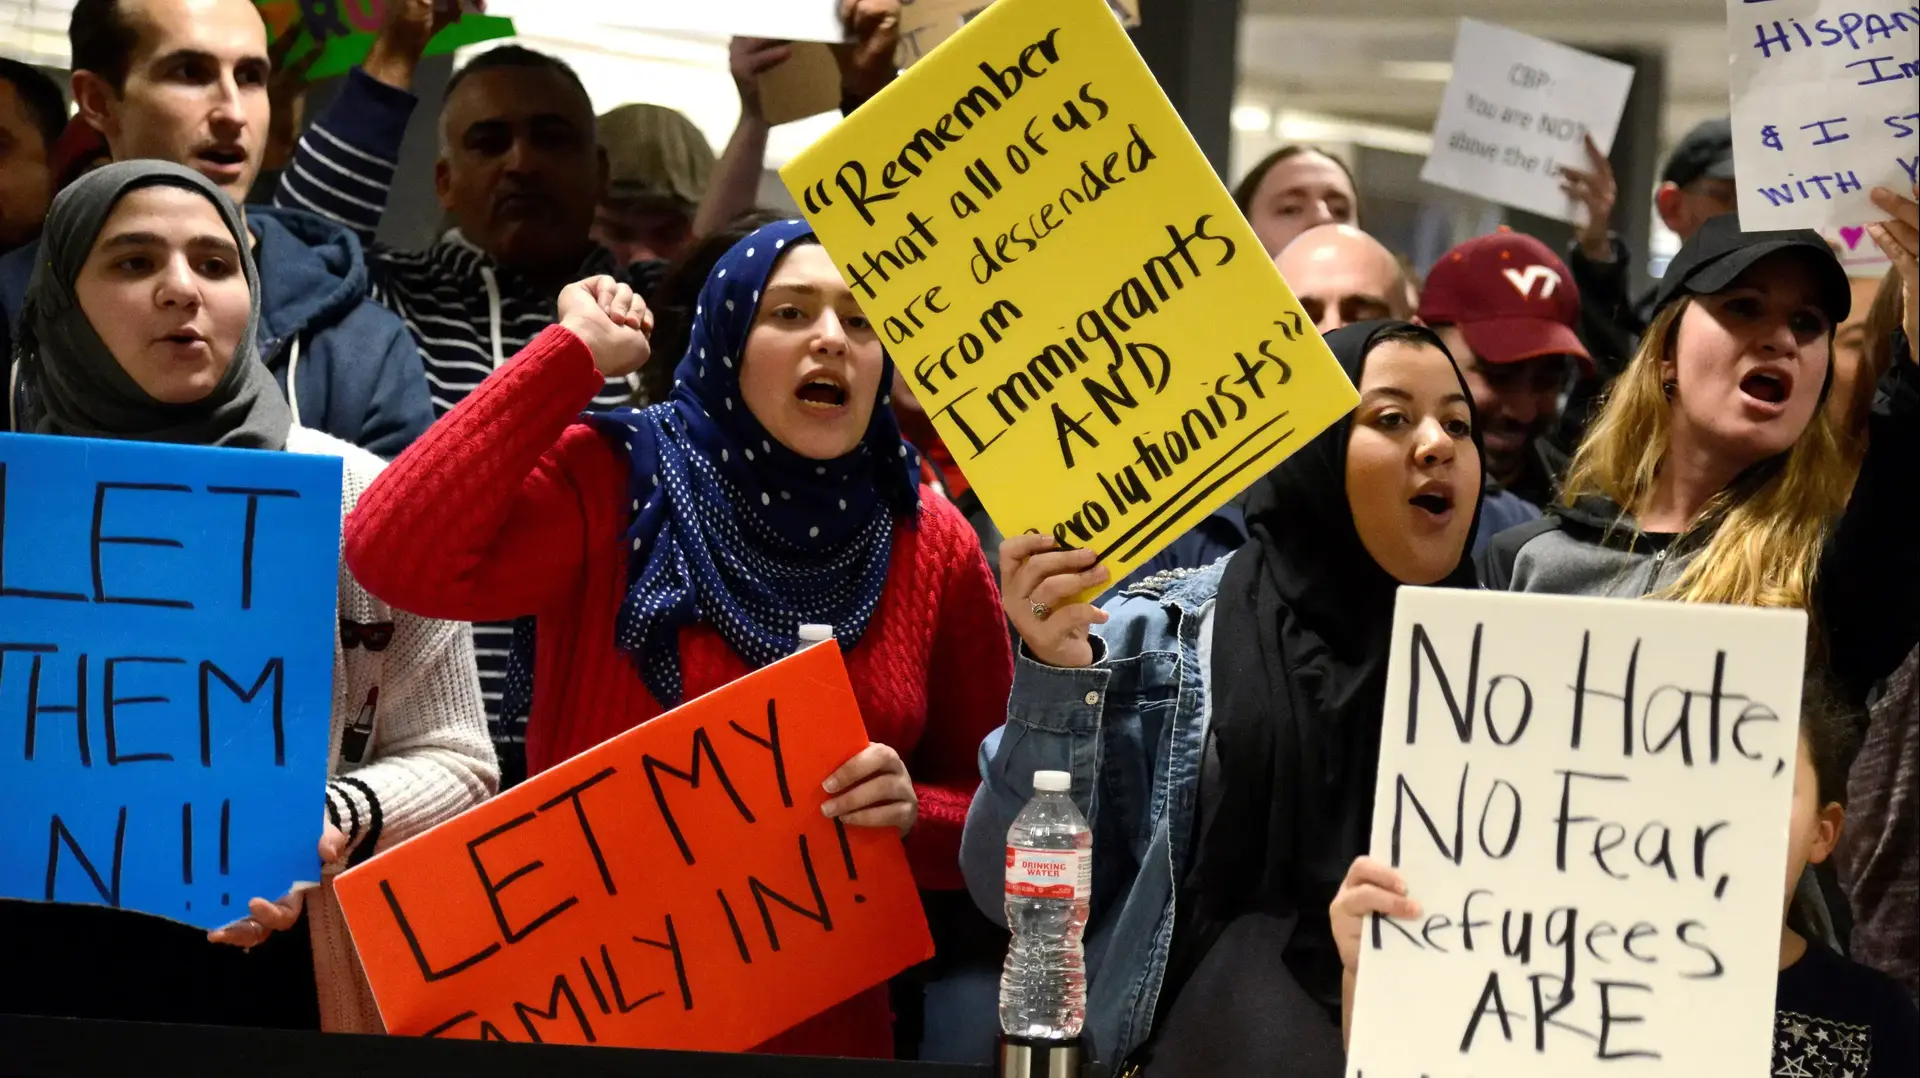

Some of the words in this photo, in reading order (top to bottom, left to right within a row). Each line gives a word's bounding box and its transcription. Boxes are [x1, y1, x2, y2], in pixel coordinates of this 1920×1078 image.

[1447, 129, 1499, 164] above
[1501, 145, 1540, 173] the
[1465, 90, 1498, 121] You
[1500, 105, 1534, 131] are
[1761, 125, 1783, 151] &
[1800, 117, 1849, 145] I
[847, 211, 938, 299] that
[950, 158, 1003, 219] all
[1053, 81, 1109, 135] us
[883, 286, 951, 344] are
[970, 123, 1157, 284] descended
[930, 214, 1236, 460] Immigrants
[1502, 264, 1562, 300] VT
[1023, 310, 1304, 551] evolutionists”
[1050, 342, 1172, 469] AND
[0, 462, 300, 610] LET
[1405, 621, 1533, 746] No
[1567, 629, 1786, 777] Hate,
[379, 766, 617, 983] LET
[641, 697, 794, 866] MY
[1022, 861, 1067, 871] DRINKING
[1027, 868, 1060, 878] WATER
[1554, 770, 1731, 899] Fear,
[423, 914, 693, 1043] MILY
[717, 816, 867, 964] IN!
[1460, 971, 1662, 1060] ARE
